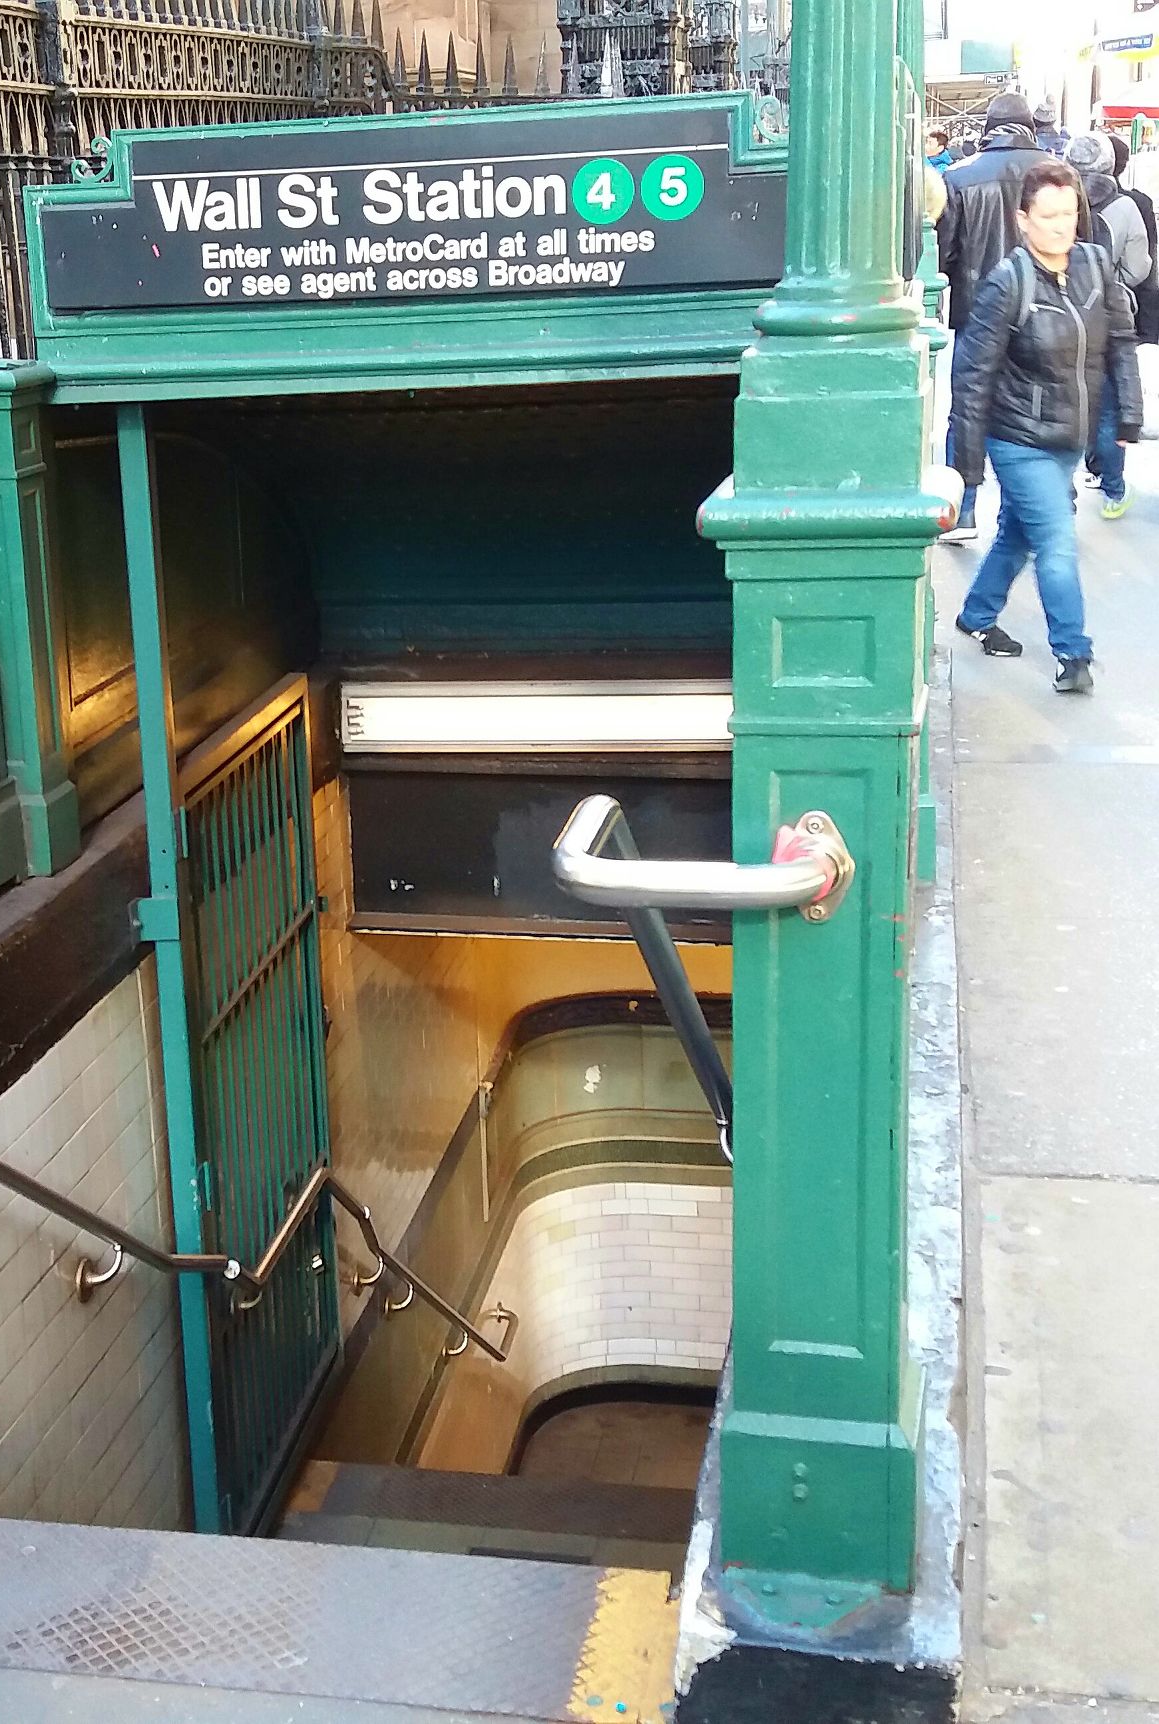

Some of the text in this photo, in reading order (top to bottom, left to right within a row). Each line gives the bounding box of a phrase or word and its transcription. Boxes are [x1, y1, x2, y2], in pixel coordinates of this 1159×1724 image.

[152, 165, 687, 232] Wall St Station 4 5
[201, 225, 655, 269] Enter with MetroCard at all times
[204, 256, 626, 299] or see agent across Broadway
